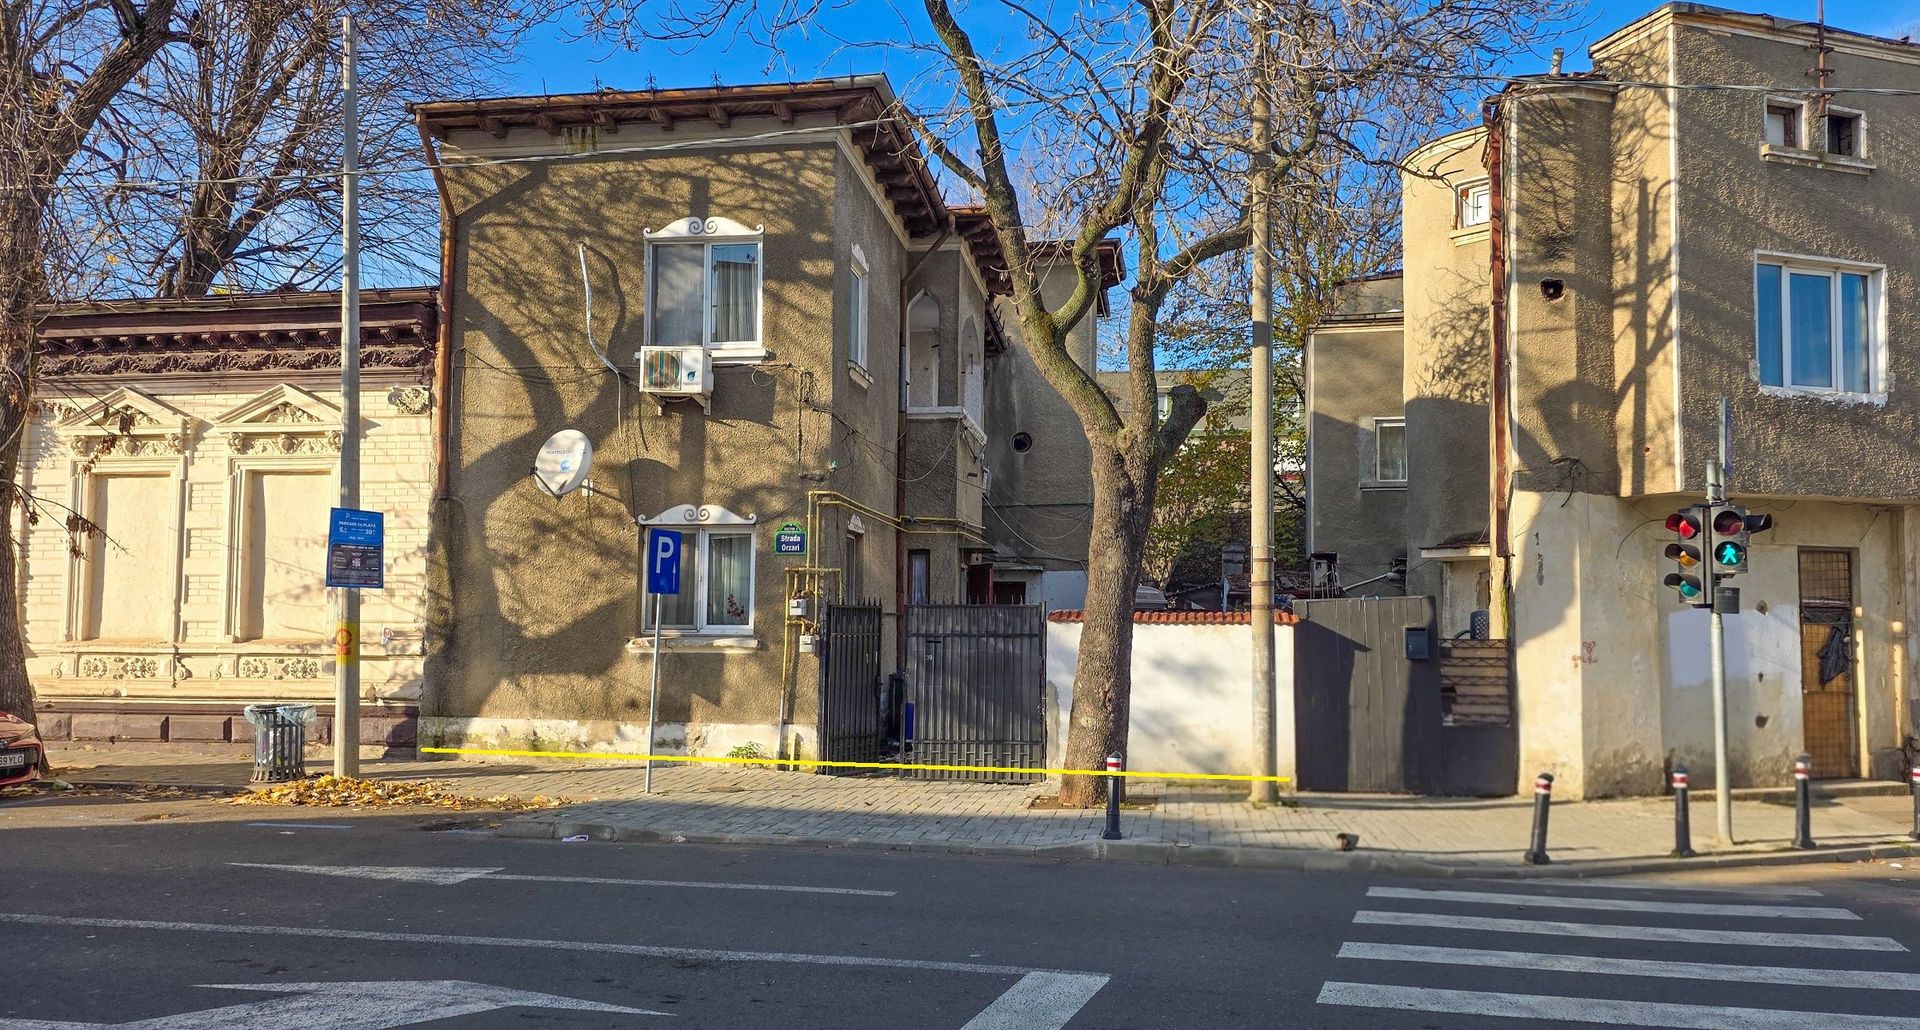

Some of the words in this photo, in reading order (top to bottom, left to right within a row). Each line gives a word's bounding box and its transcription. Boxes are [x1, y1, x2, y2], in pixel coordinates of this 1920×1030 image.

[781, 534, 800, 542] Strada
[655, 535, 675, 574] P
[9, 755, 23, 764] YLO
